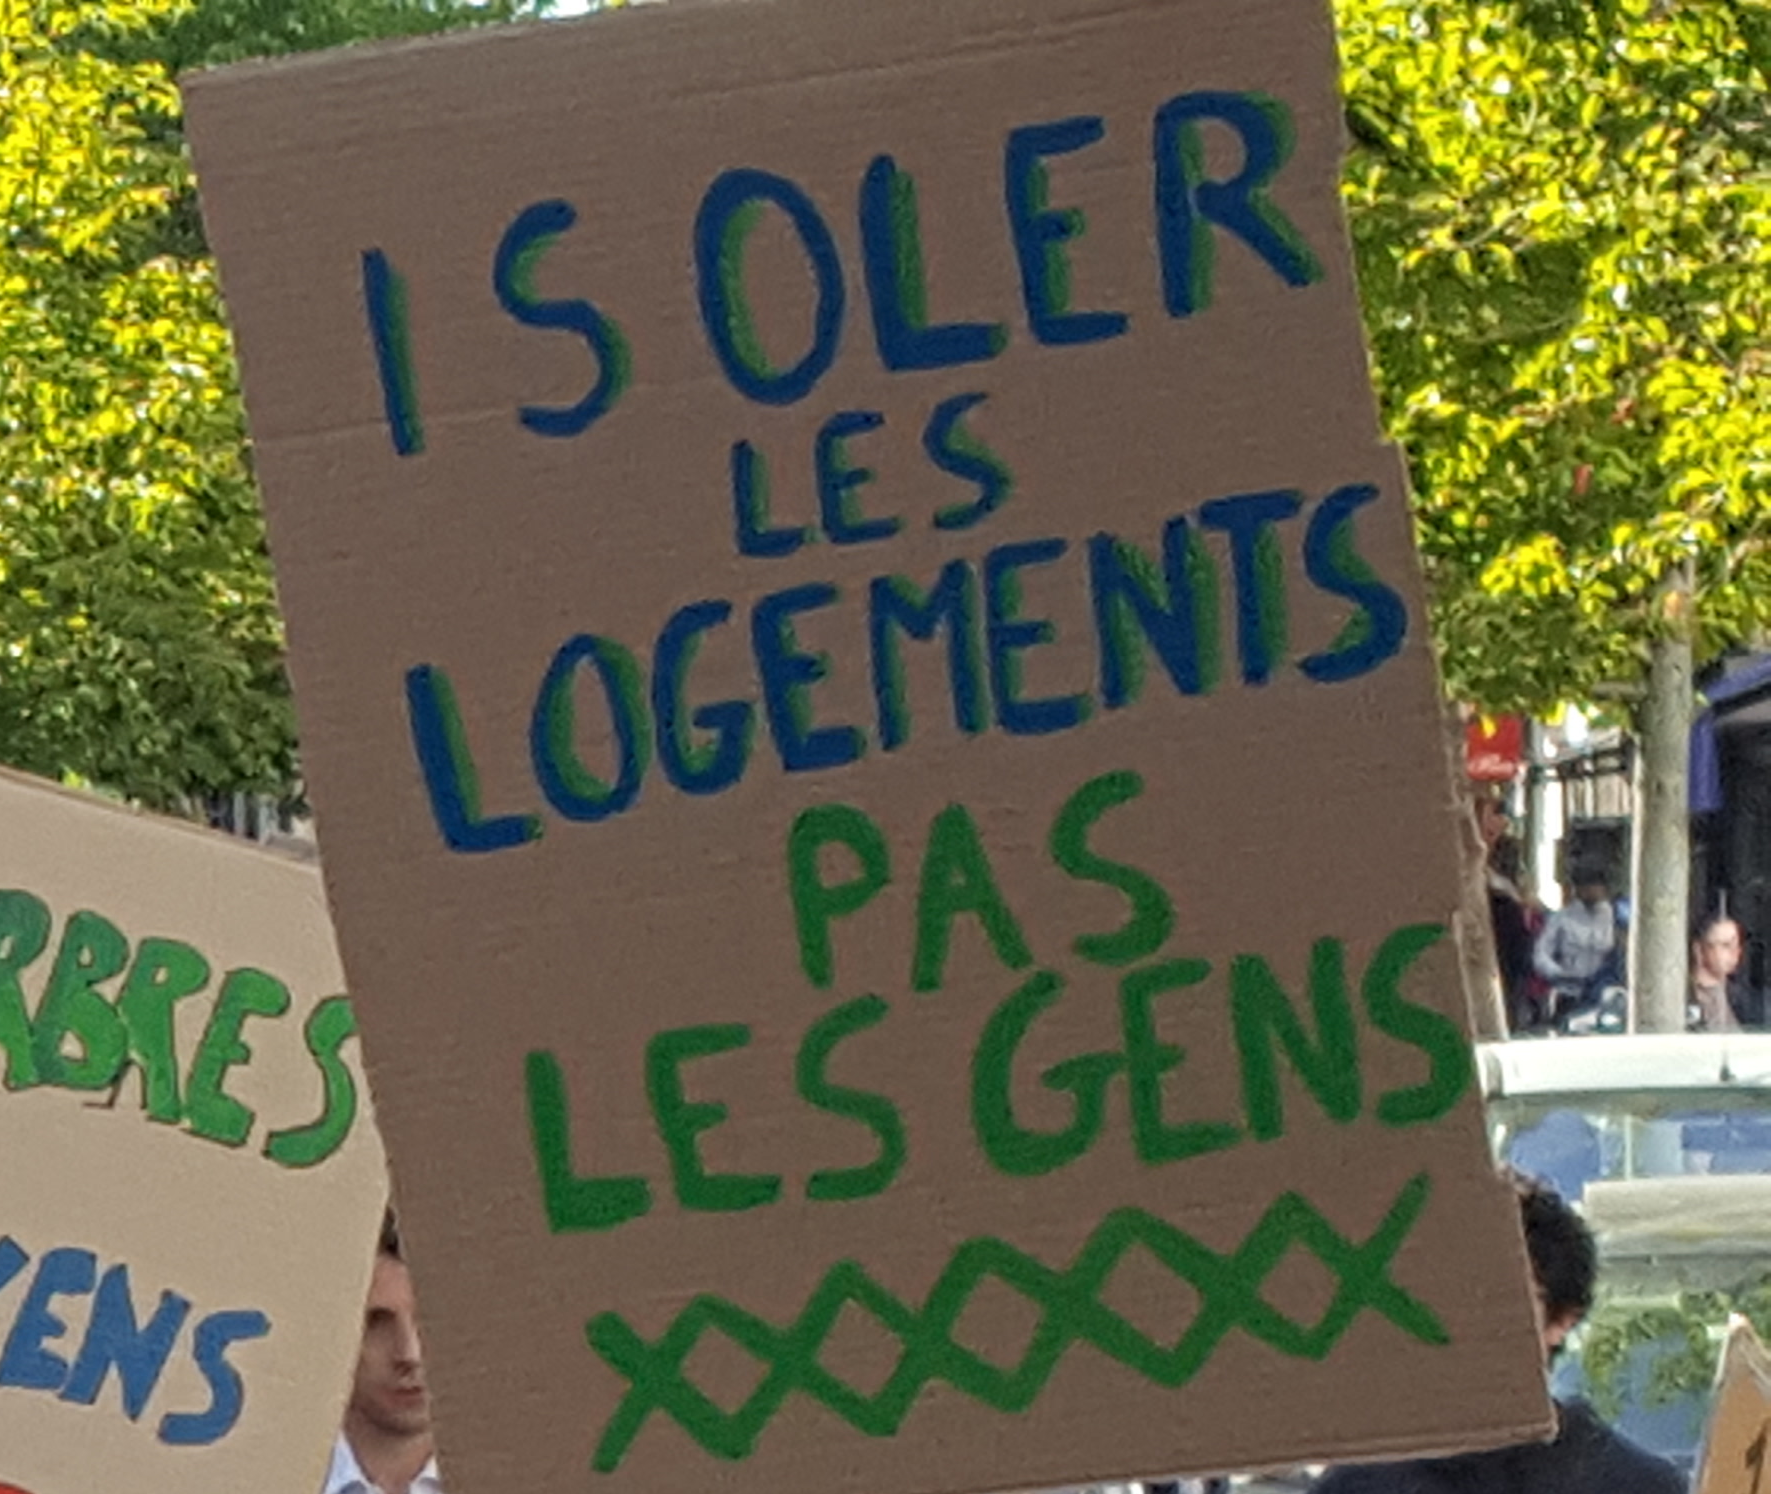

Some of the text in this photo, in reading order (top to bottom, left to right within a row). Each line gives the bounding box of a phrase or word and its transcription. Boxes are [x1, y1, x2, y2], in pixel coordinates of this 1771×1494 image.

[730, 391, 1016, 558] LES
[405, 482, 1409, 854] LOGEMENTS
[785, 768, 1178, 993] PAS
[524, 923, 1475, 1234] LES GENS
